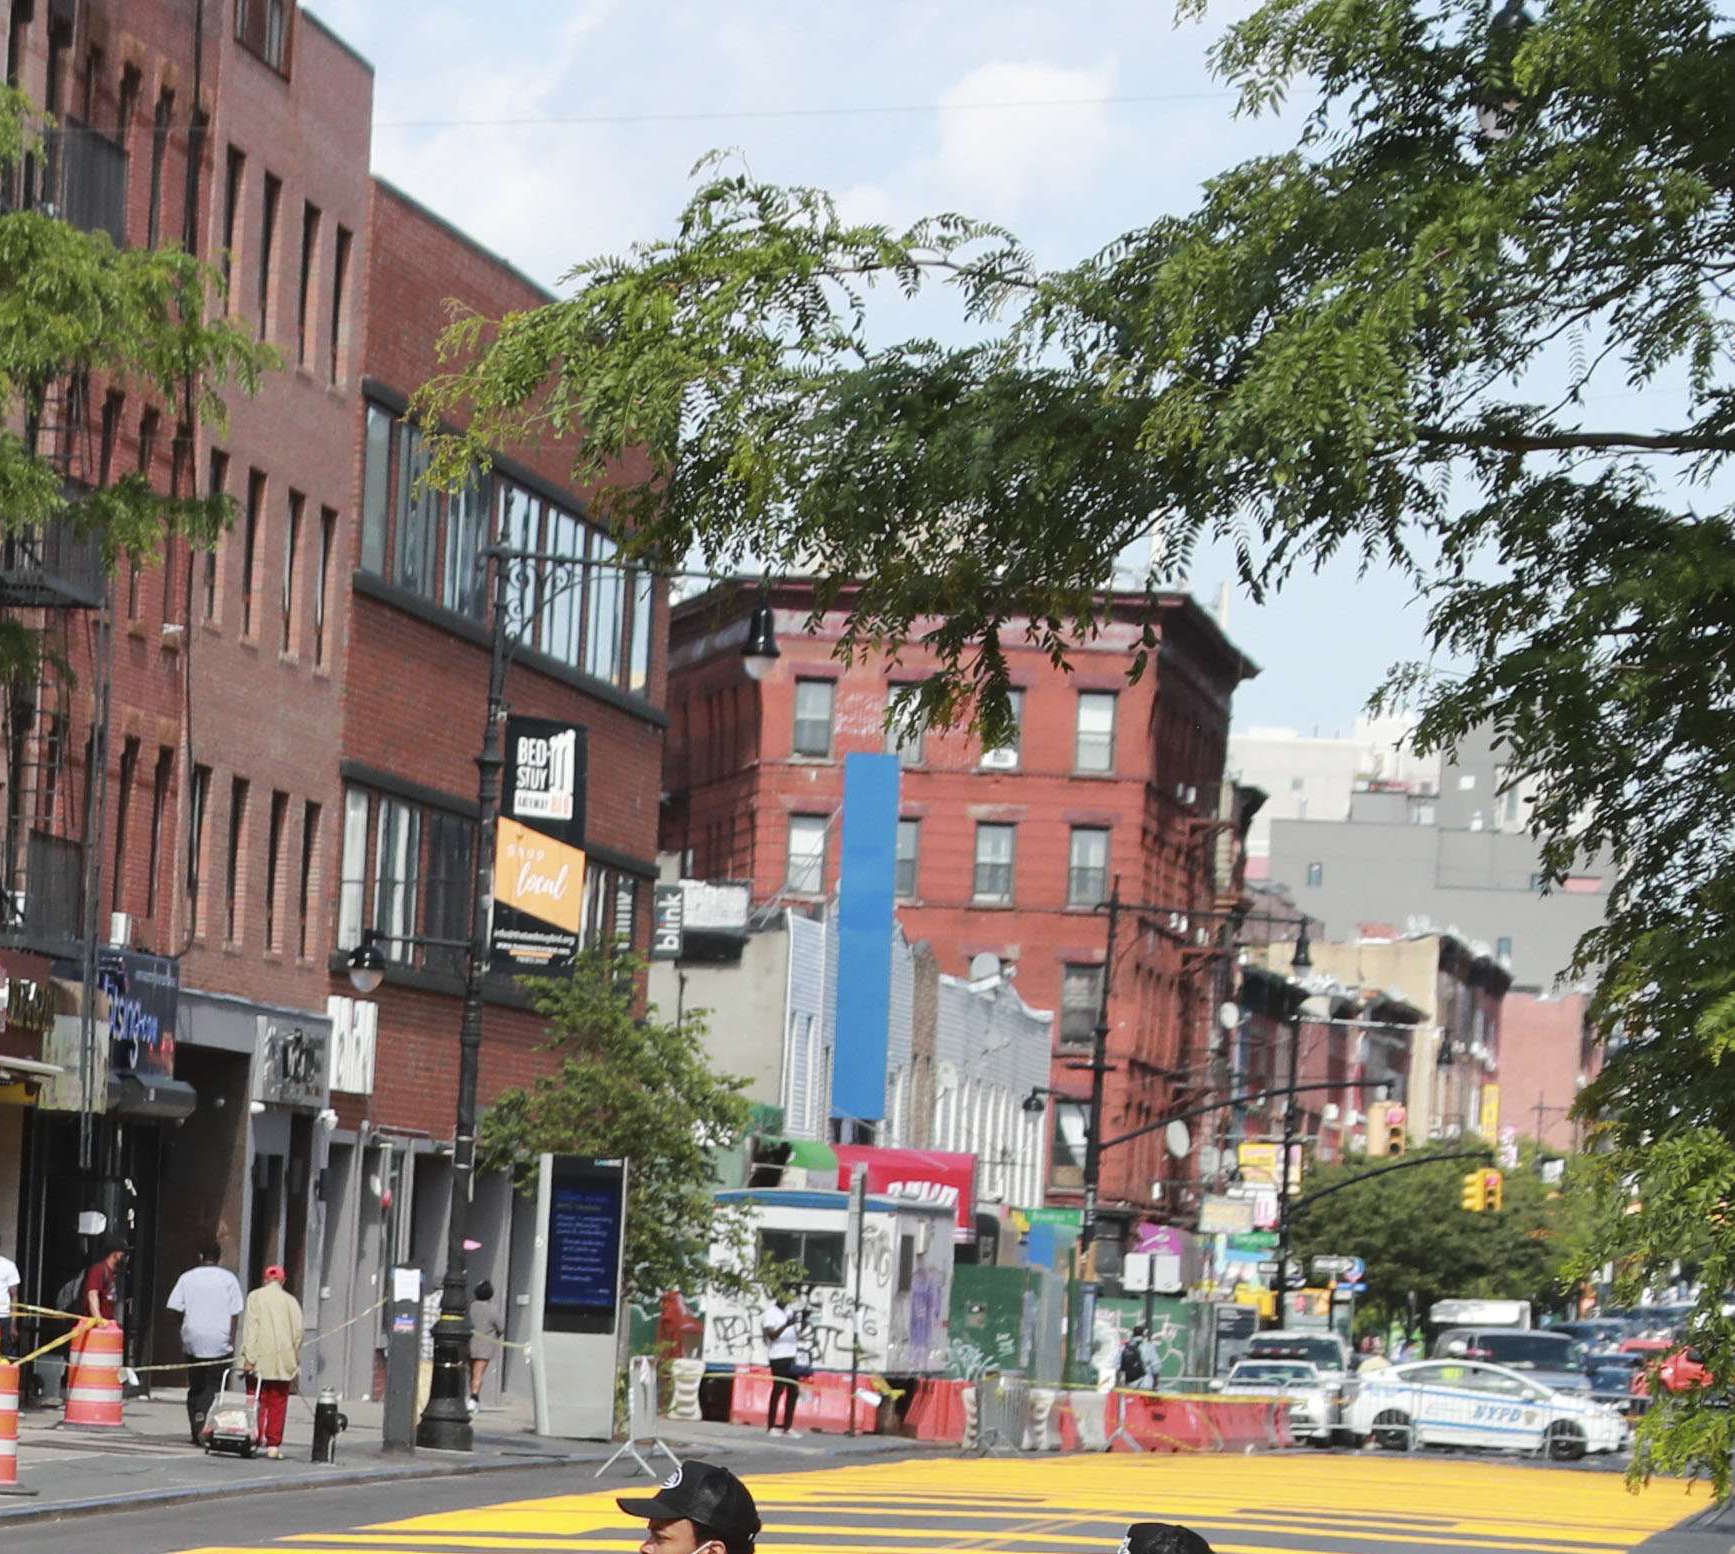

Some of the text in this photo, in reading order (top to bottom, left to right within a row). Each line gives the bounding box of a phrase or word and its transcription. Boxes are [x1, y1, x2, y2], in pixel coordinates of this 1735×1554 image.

[516, 735, 551, 768] BED-
[515, 765, 549, 791] STUY
[516, 860, 571, 900] local
[654, 892, 683, 951] blink
[1473, 1404, 1523, 1423] NYPD
